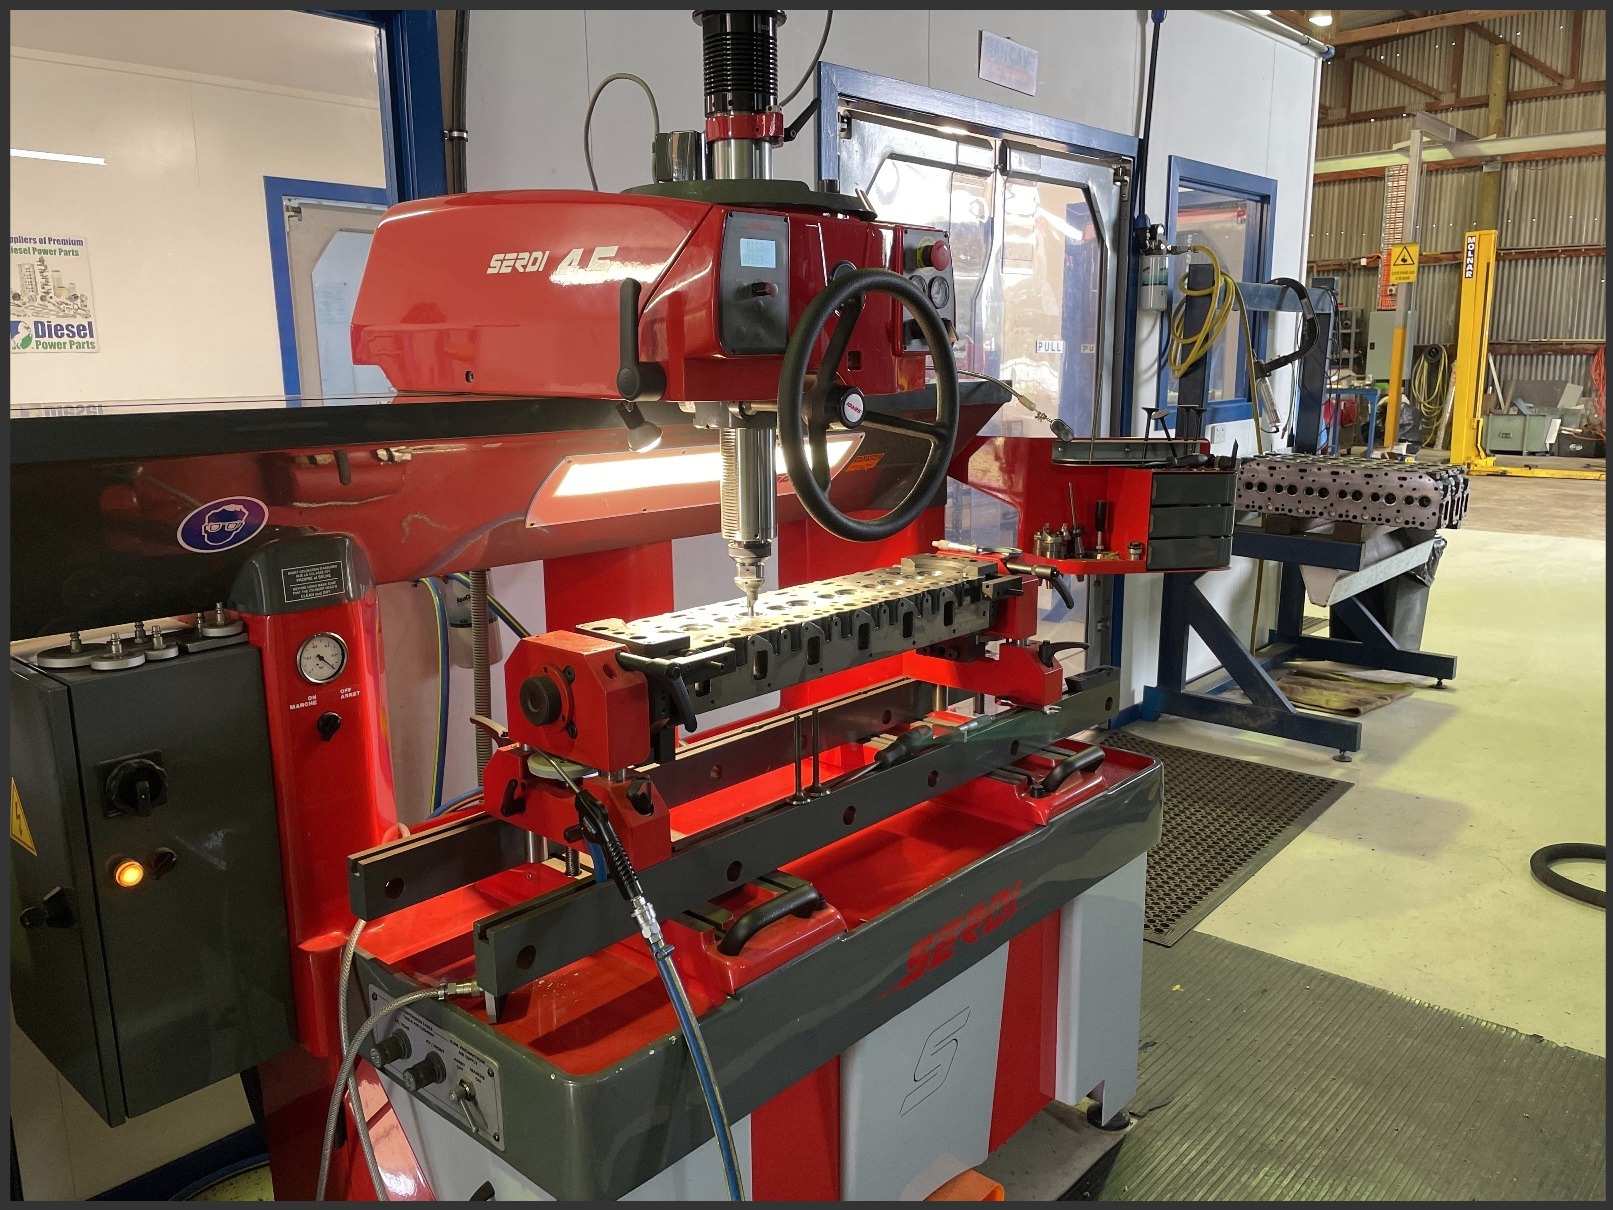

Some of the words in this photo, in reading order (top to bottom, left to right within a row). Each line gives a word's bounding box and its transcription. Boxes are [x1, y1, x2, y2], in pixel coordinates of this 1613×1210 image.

[48, 237, 84, 246] Premium
[32, 247, 57, 255] Power
[59, 248, 79, 256] Parts
[1465, 236, 1476, 278] MOLNAR
[486, 250, 550, 274] SERDI
[34, 320, 94, 338] Diesel
[35, 340, 67, 349] Power
[69, 340, 96, 349] Parts
[1038, 341, 1062, 352] PULL
[340, 691, 361, 700] ARRET
[289, 701, 318, 710] MARCHE
